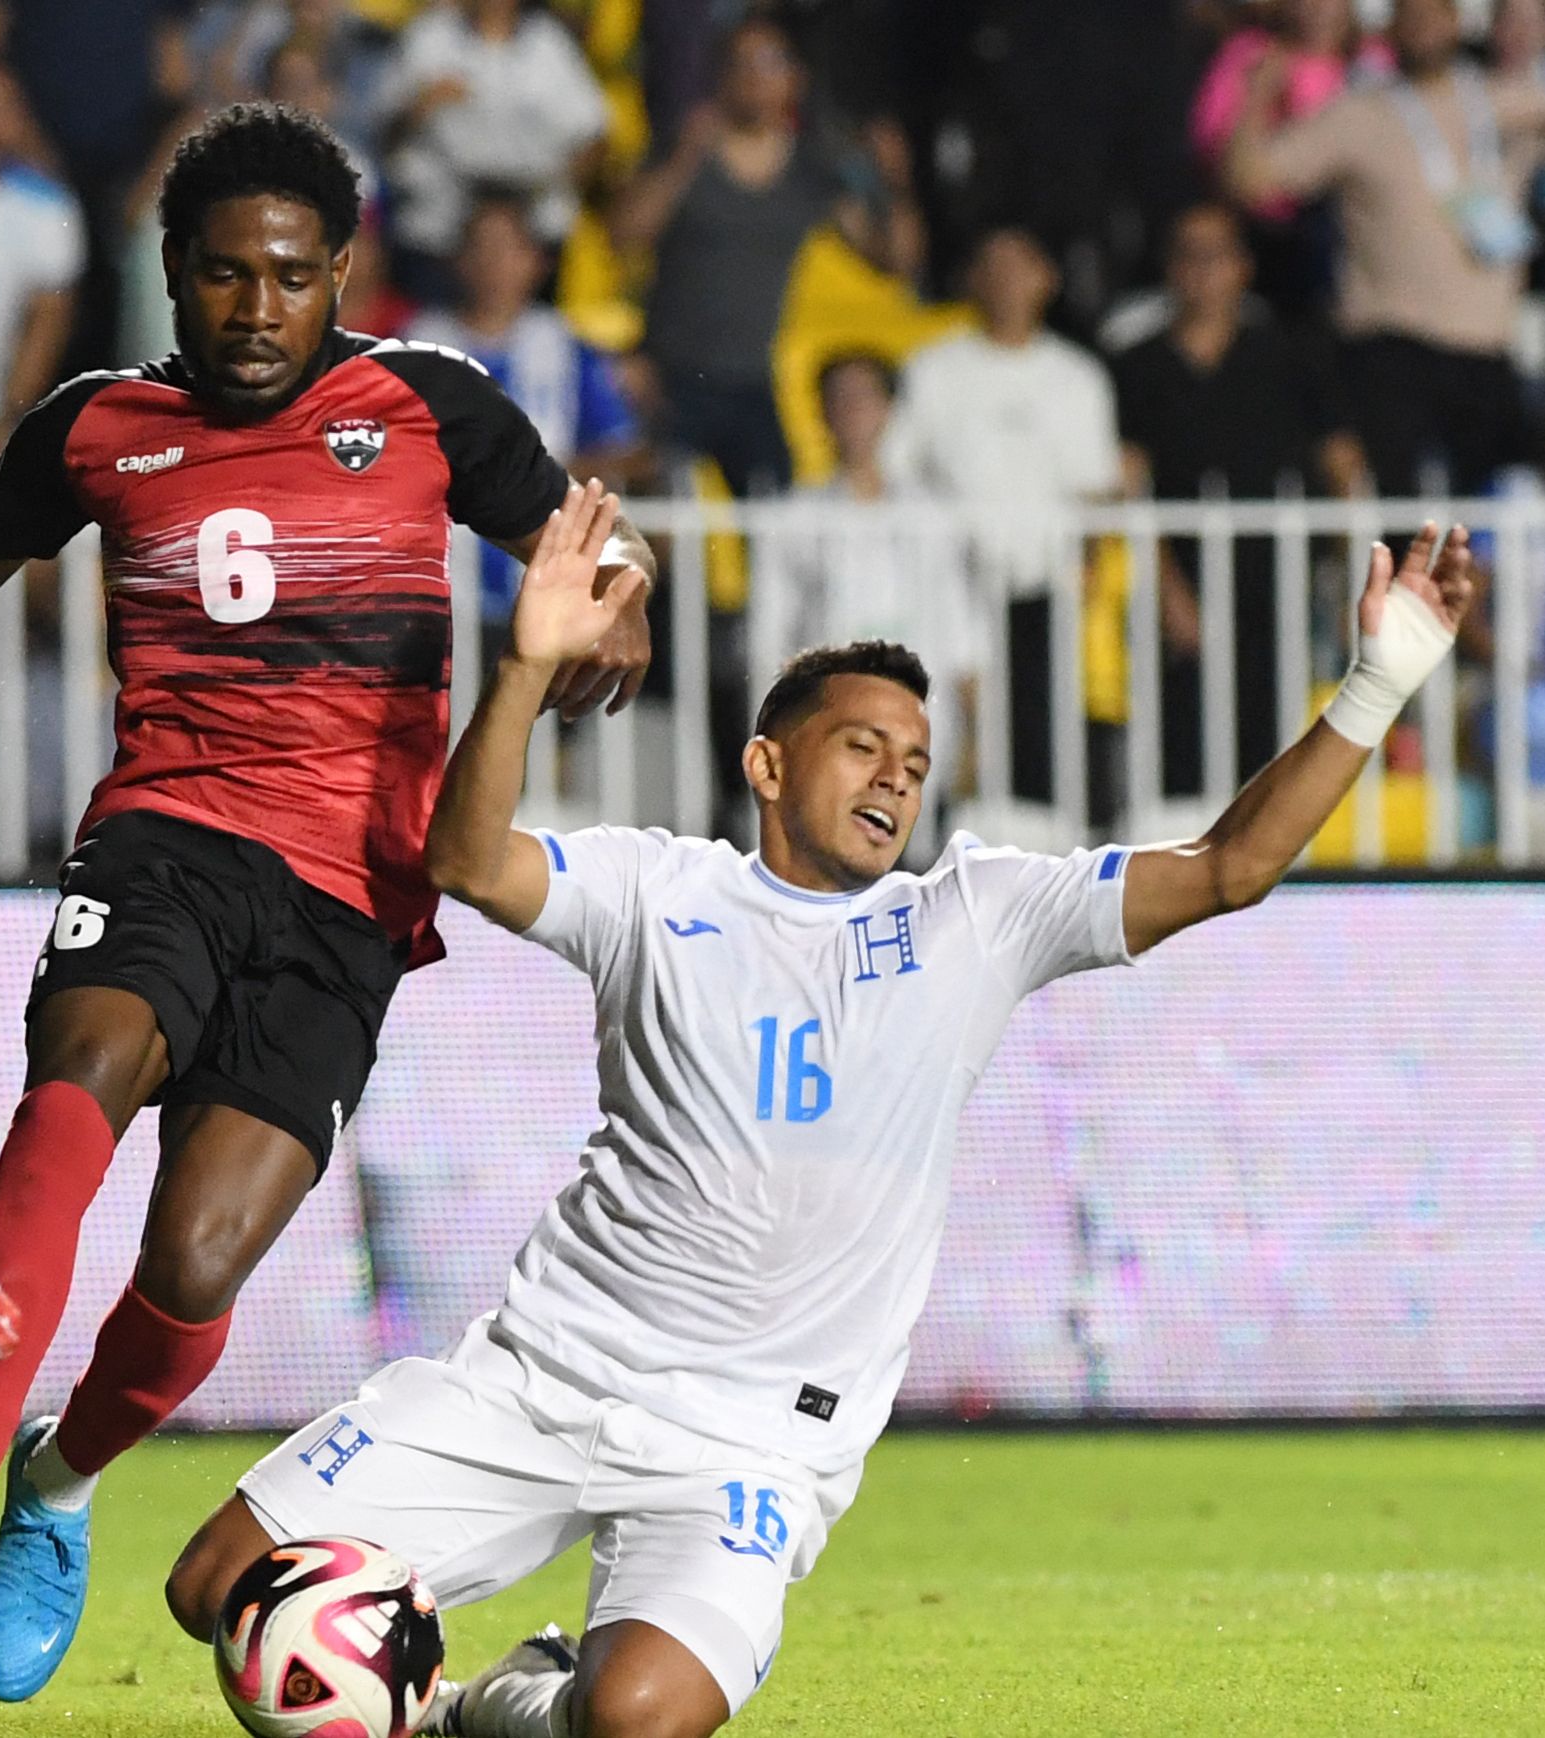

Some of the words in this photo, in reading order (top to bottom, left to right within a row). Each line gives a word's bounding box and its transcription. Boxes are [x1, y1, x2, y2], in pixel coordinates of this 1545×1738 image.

[116, 446, 184, 474] capelli
[197, 507, 276, 624] 6
[54, 894, 111, 950] 6
[847, 904, 923, 982] H
[748, 1016, 833, 1123] 16
[716, 1481, 788, 1552] 16
